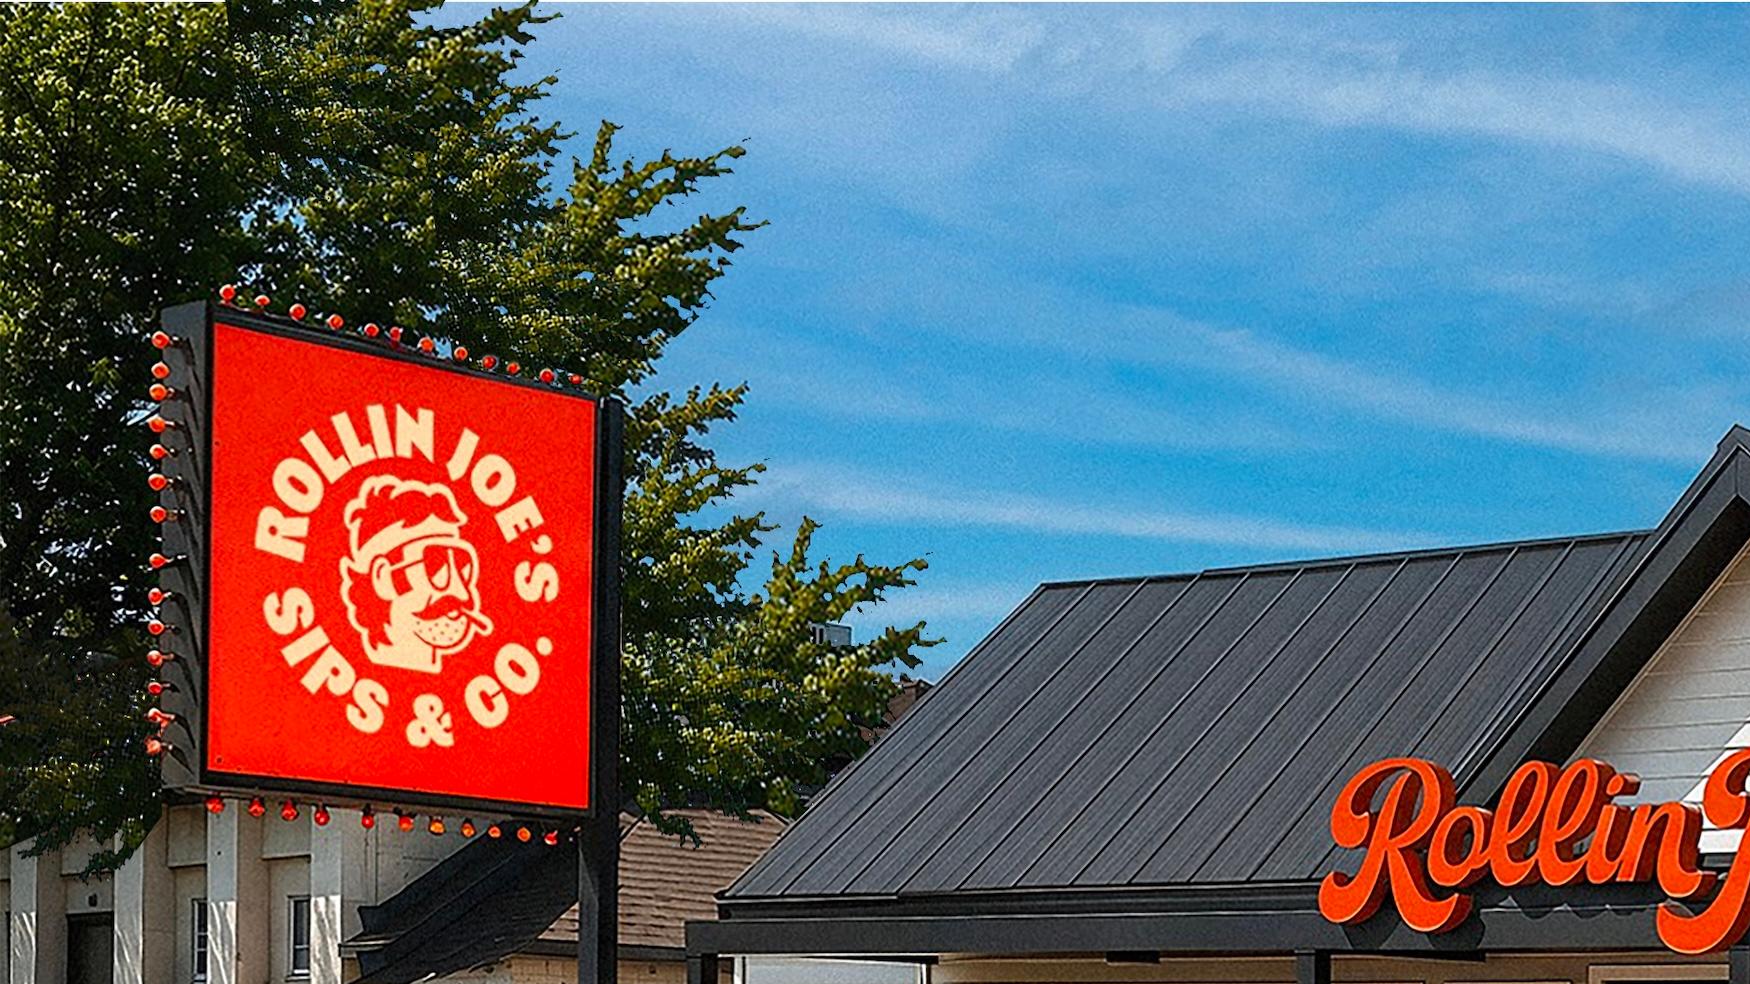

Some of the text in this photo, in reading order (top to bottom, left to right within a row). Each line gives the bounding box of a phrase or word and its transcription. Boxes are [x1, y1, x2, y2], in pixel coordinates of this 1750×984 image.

[254, 403, 560, 604] ROLLIN JOE'S
[262, 584, 554, 749] SIPS & CO.
[1318, 756, 1718, 934] Rollin
